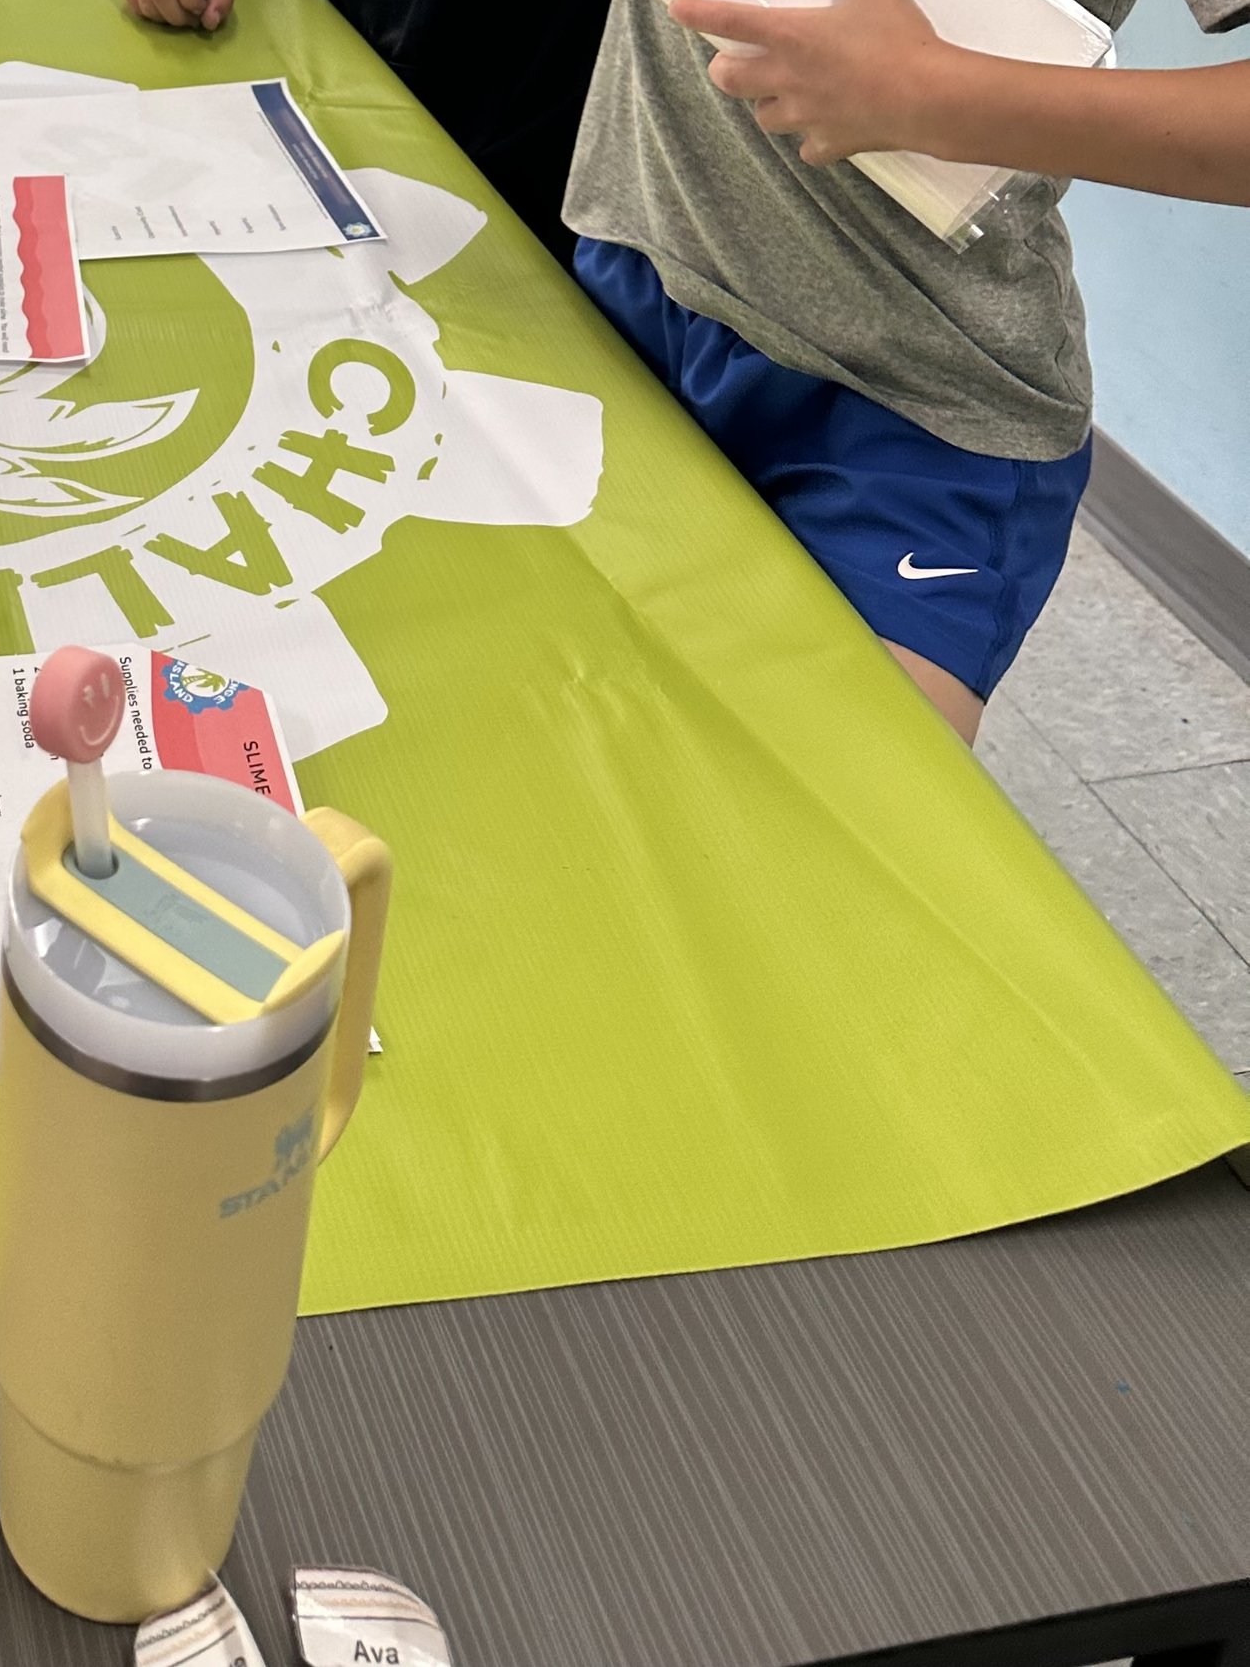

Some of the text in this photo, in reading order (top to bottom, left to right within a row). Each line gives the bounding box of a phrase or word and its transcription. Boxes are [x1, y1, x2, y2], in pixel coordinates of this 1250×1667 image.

[13, 677, 29, 717] baking
[21, 720, 35, 749] soda
[119, 656, 152, 770] Supplies needed to
[243, 740, 272, 796] SLIME
[354, 1640, 400, 1666] Ava
